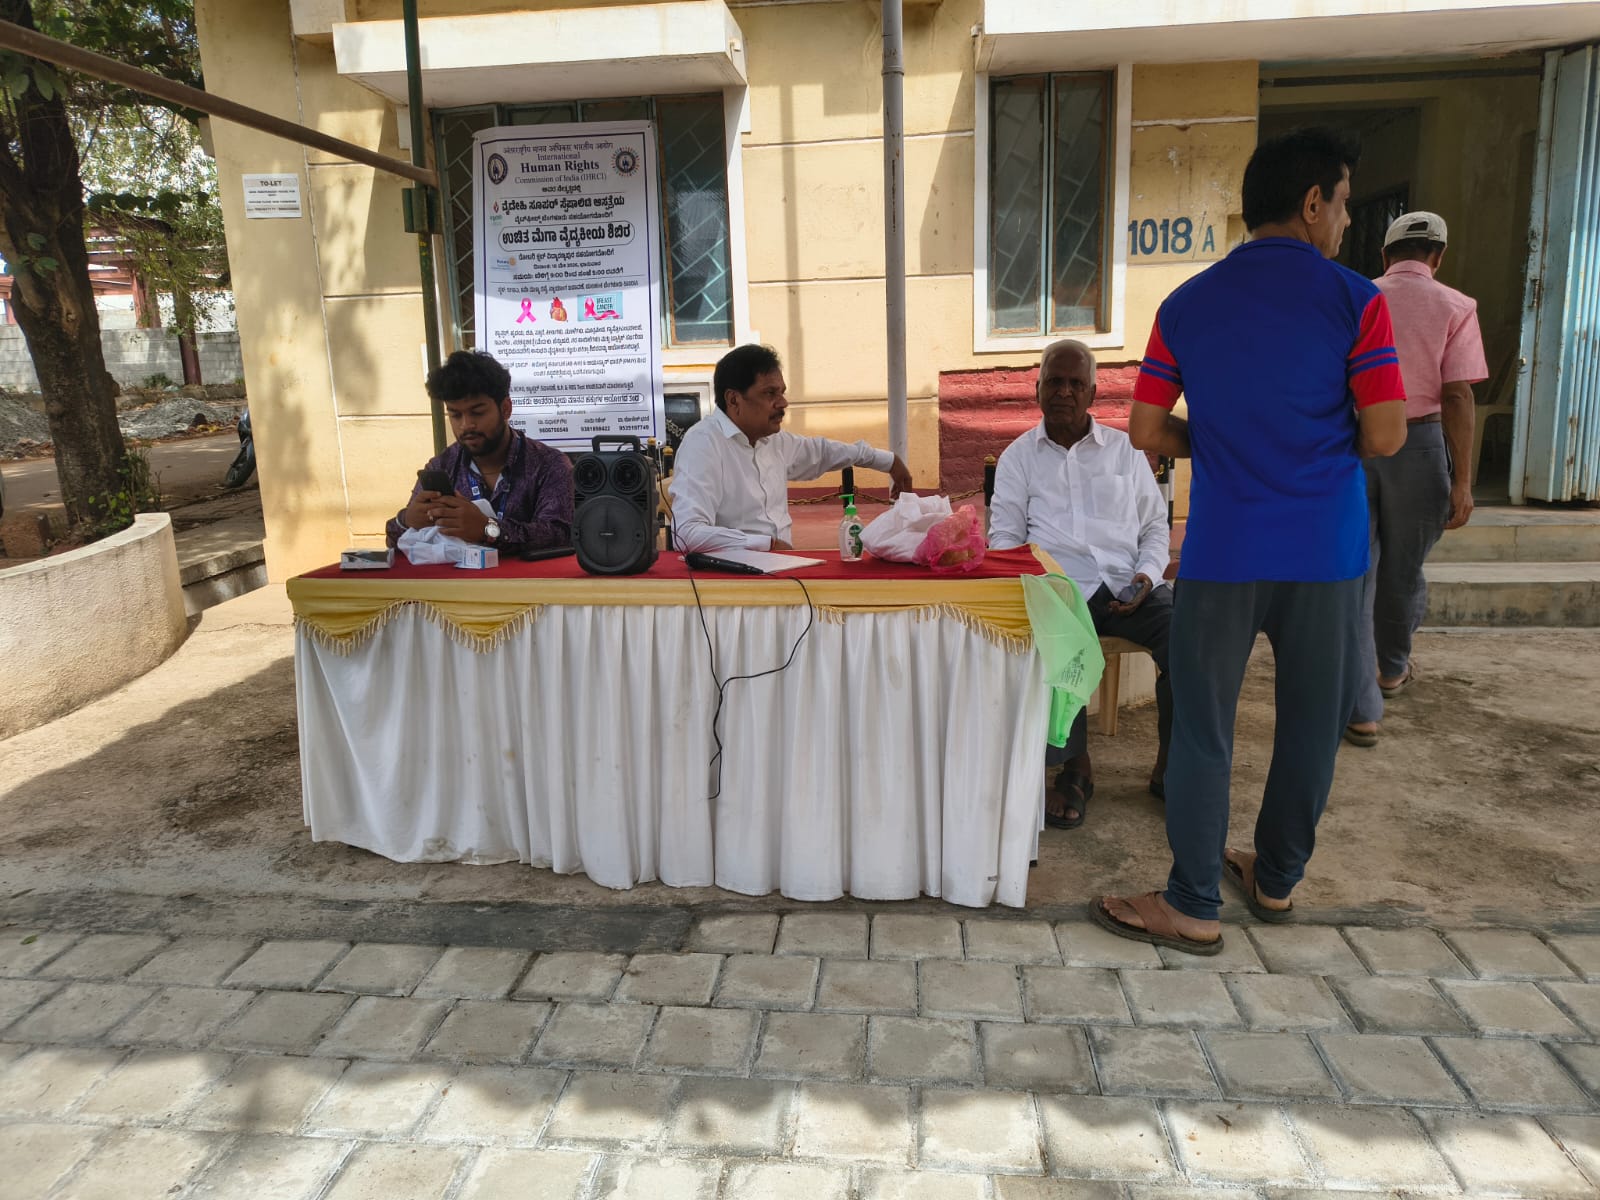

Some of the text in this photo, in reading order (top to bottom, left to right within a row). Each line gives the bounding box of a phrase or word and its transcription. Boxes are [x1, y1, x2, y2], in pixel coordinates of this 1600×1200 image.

[537, 153, 581, 161] International
[521, 160, 600, 173] Human Rights
[514, 176, 554, 184] Commission
[563, 175, 581, 183] India
[502, 223, 631, 247] ಉಚಿತ ಮೆಗಾ ವೈದ್ಯಕೀಯ ಶಿಬಿರ
